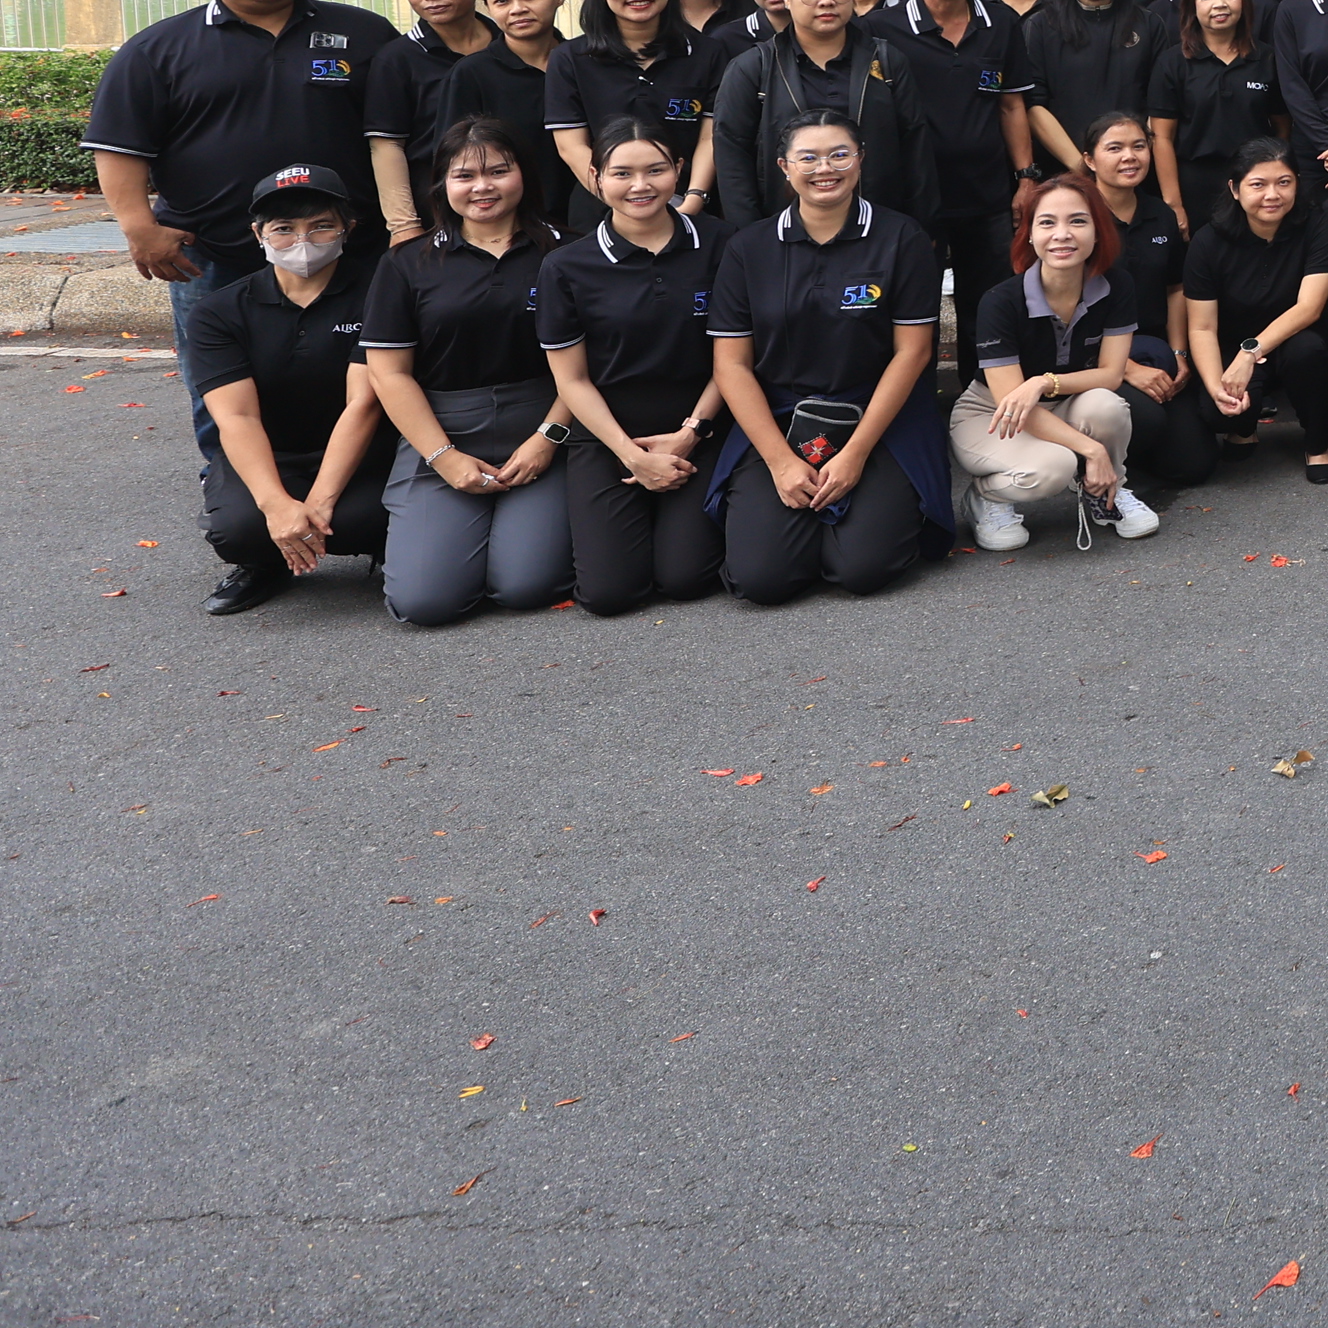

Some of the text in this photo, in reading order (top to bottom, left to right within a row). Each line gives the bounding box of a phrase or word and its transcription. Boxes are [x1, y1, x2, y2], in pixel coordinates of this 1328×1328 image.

[275, 167, 310, 180] SEEU
[277, 175, 311, 188] LIVE
[841, 284, 868, 305] 51
